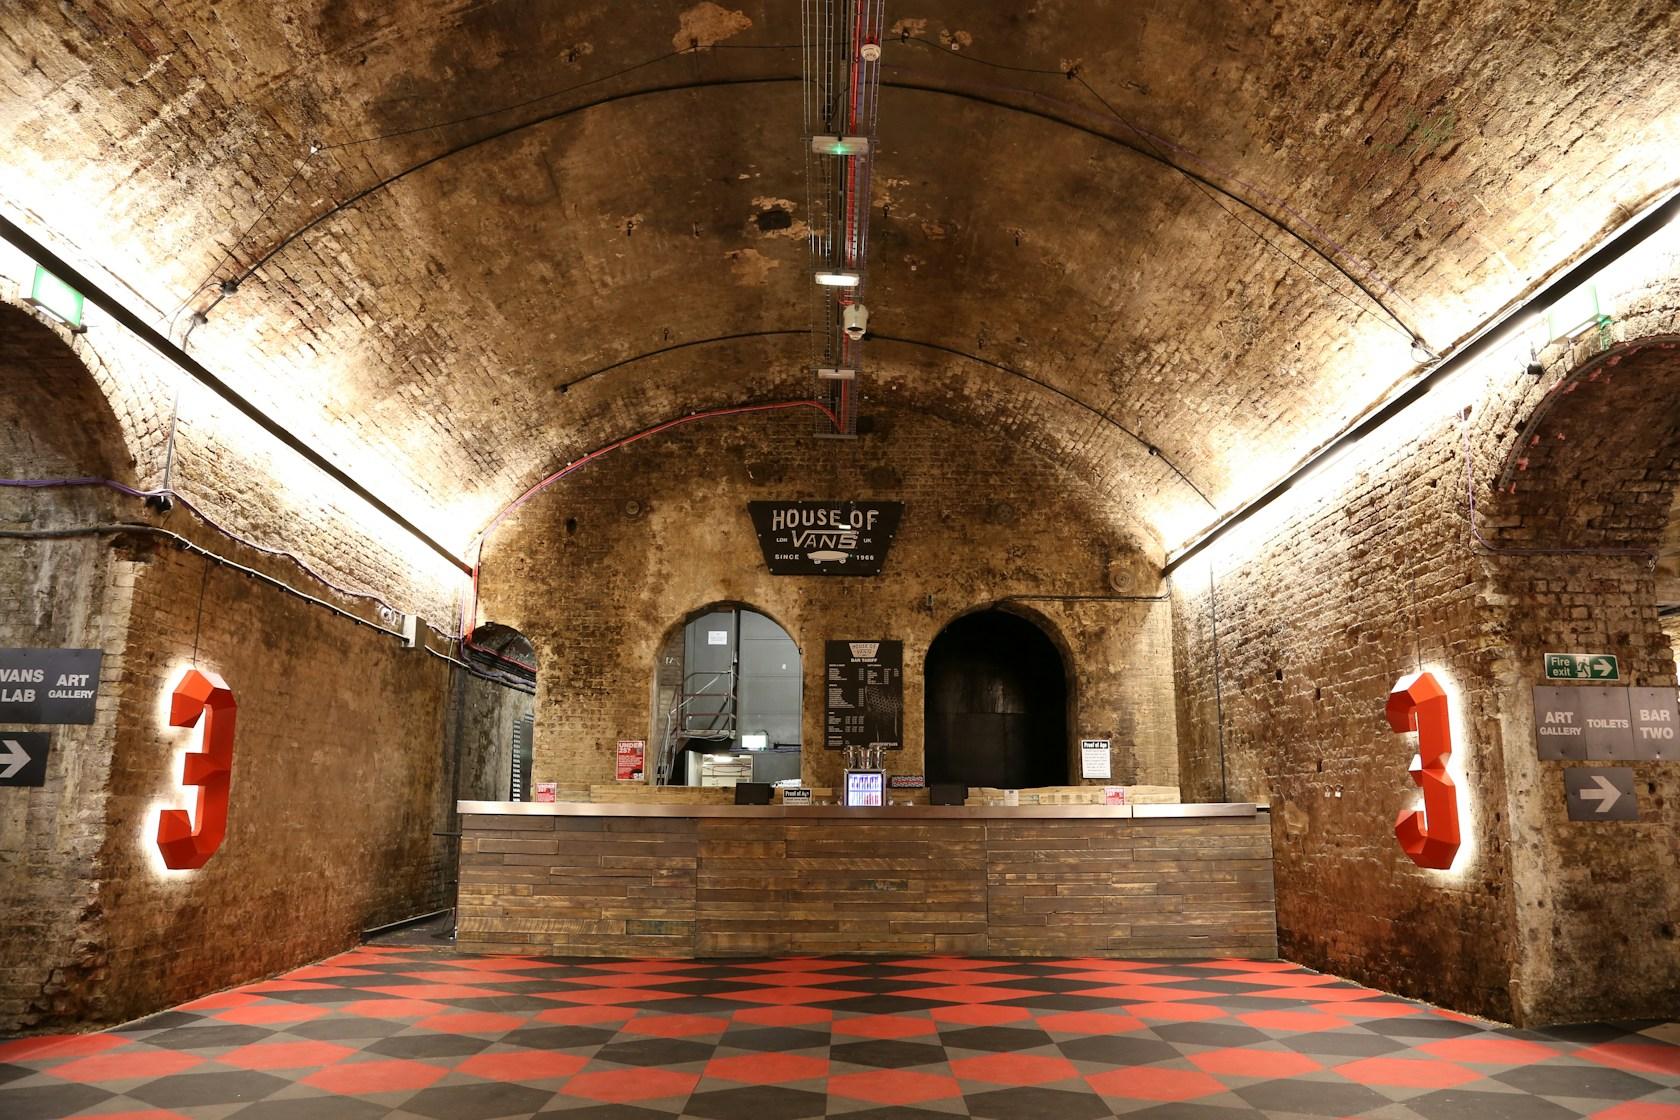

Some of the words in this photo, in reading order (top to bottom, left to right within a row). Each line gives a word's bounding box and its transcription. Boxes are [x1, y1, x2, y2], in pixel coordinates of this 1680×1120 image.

[772, 508, 841, 531] HOUSE
[850, 510, 880, 531] OF
[791, 529, 860, 549] VANS
[1550, 656, 1570, 667] Fire
[0, 669, 44, 683] VANS
[1552, 667, 1571, 677] exit
[56, 674, 90, 687] ART
[1, 689, 36, 703] LAB
[48, 689, 95, 699] GALLERY
[1545, 711, 1574, 724] ART
[1640, 709, 1671, 721] BAR
[1586, 719, 1630, 729] TOILETS
[1540, 727, 1582, 736] GALLERY
[1640, 727, 1674, 739] TWO
